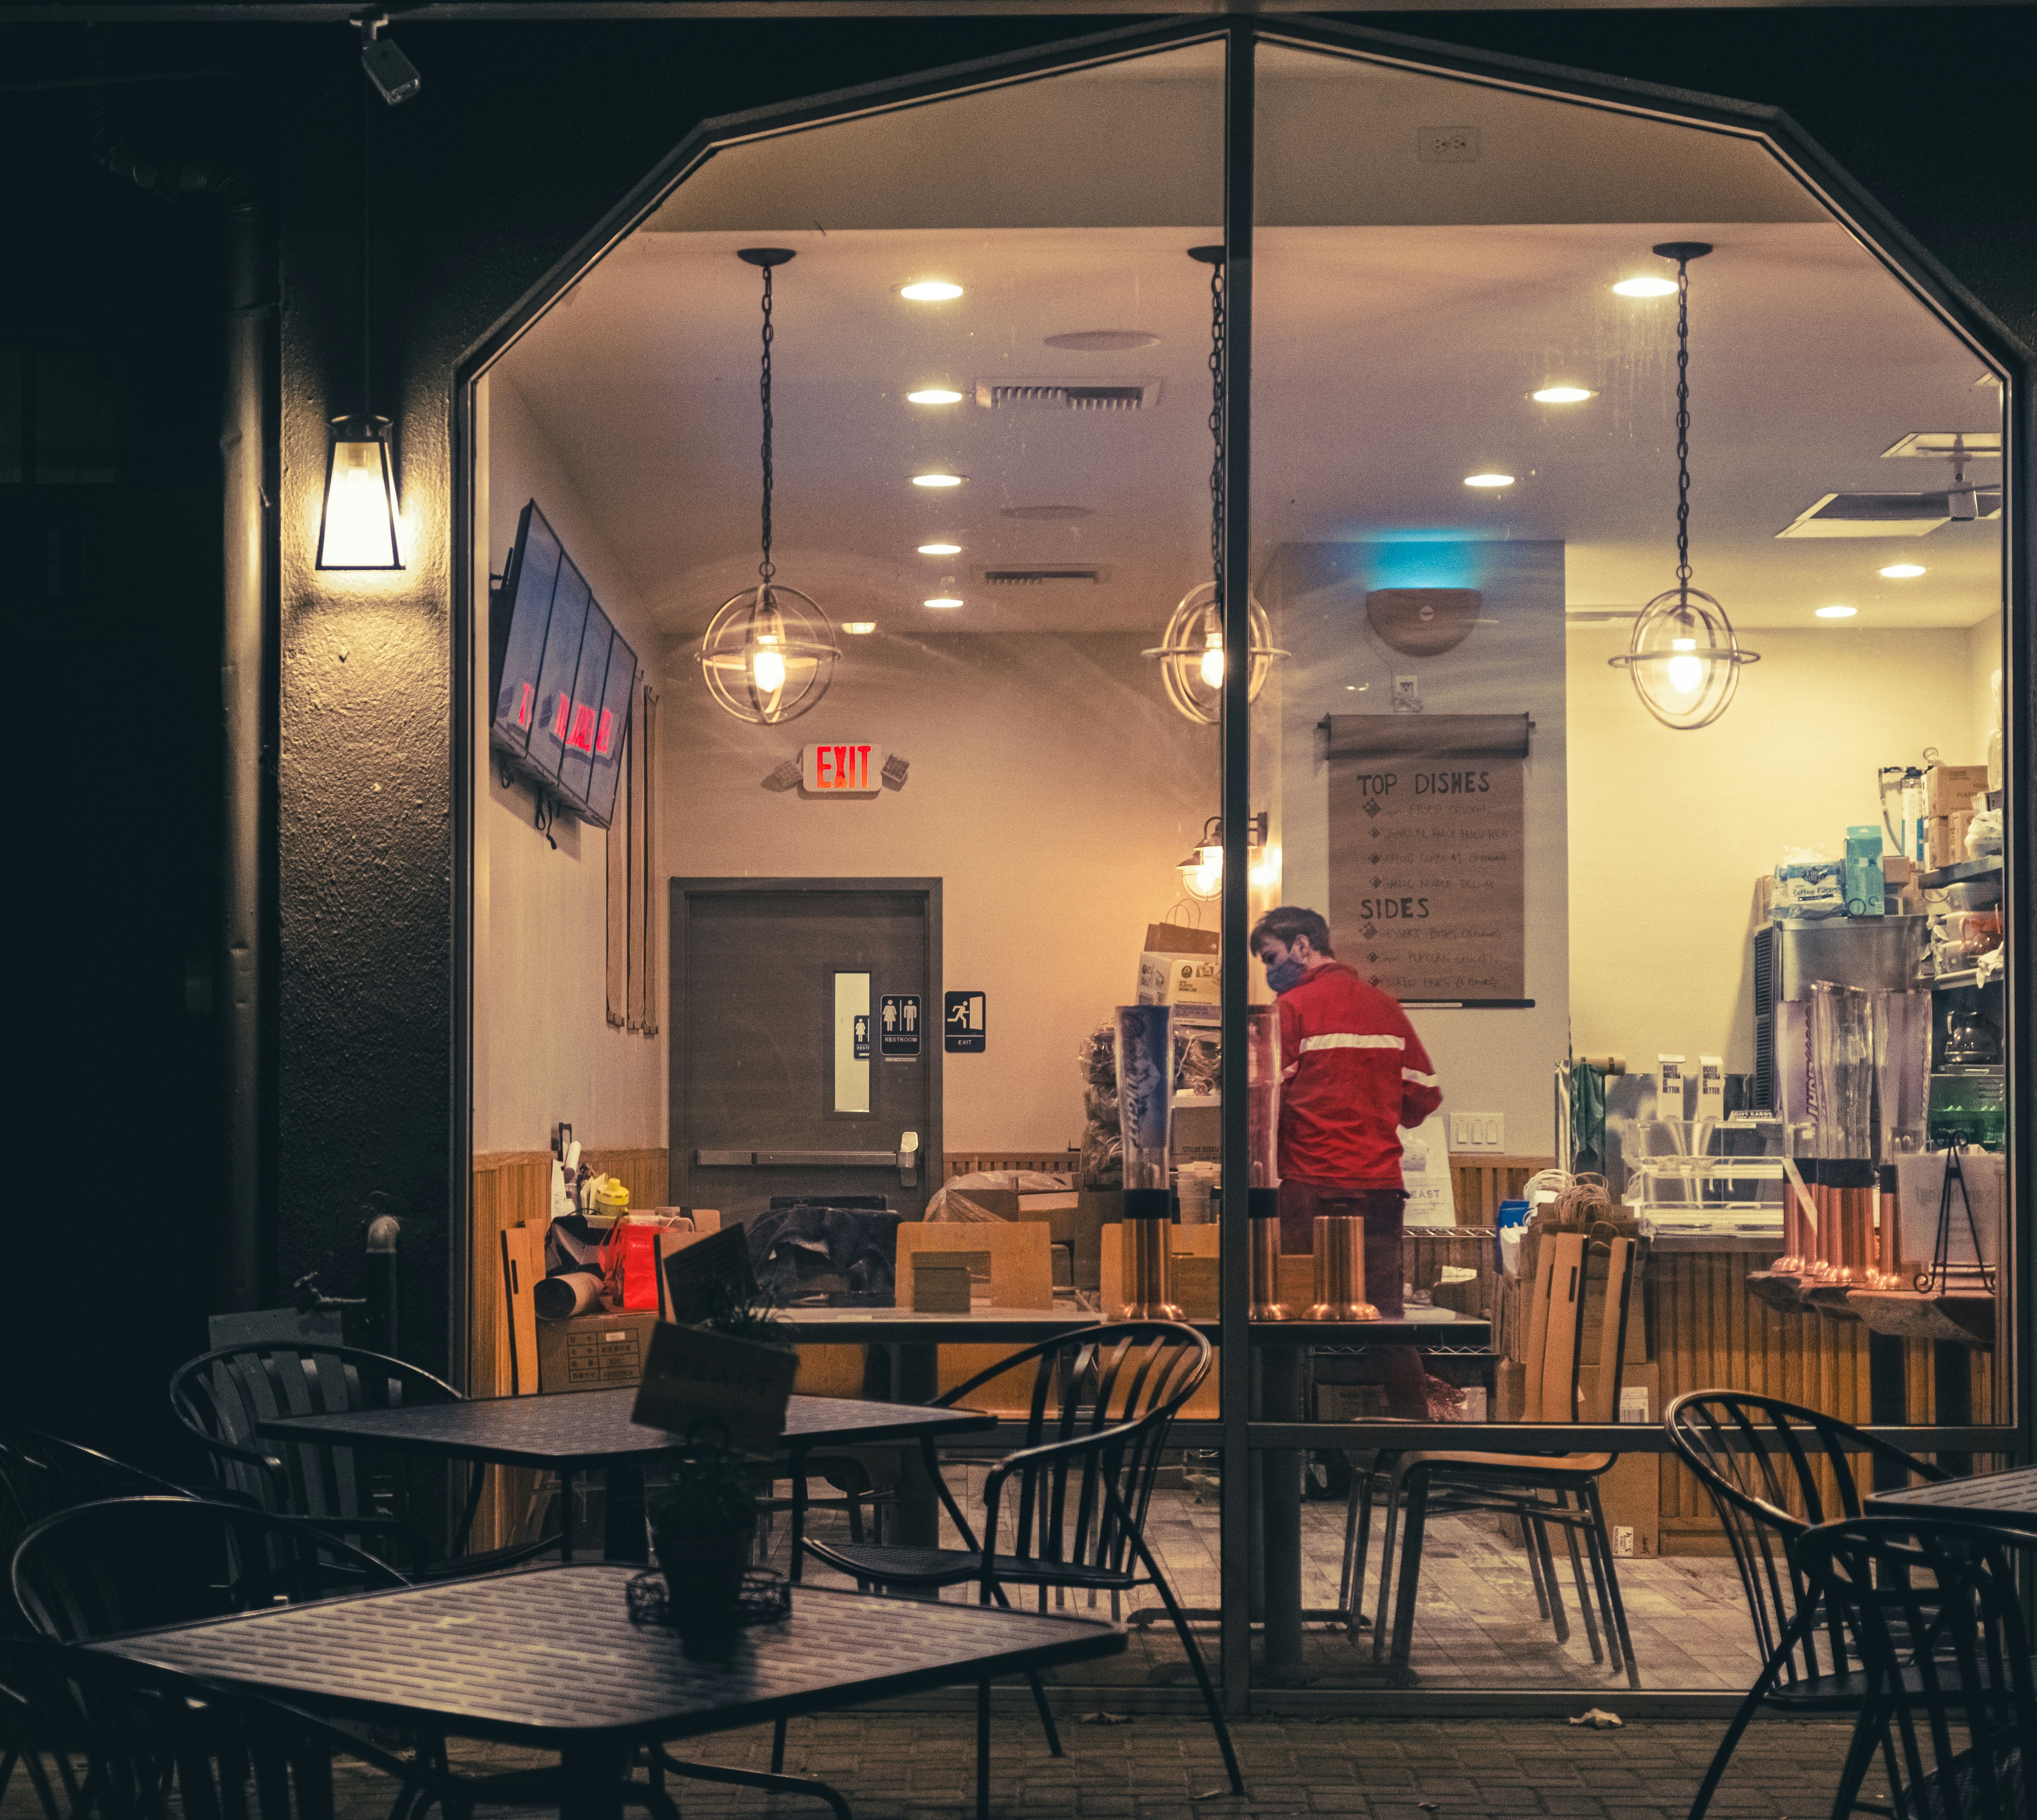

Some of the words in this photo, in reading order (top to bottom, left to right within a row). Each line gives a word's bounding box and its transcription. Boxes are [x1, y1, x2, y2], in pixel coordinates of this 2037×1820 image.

[817, 746, 872, 788] EXIT
[1357, 773, 1397, 796] TOP
[1415, 771, 1490, 794] DISHES
[1793, 888, 1815, 896] Coffee
[1360, 897, 1430, 919] SIDES
[1125, 1074, 1140, 1148] LIGHT
